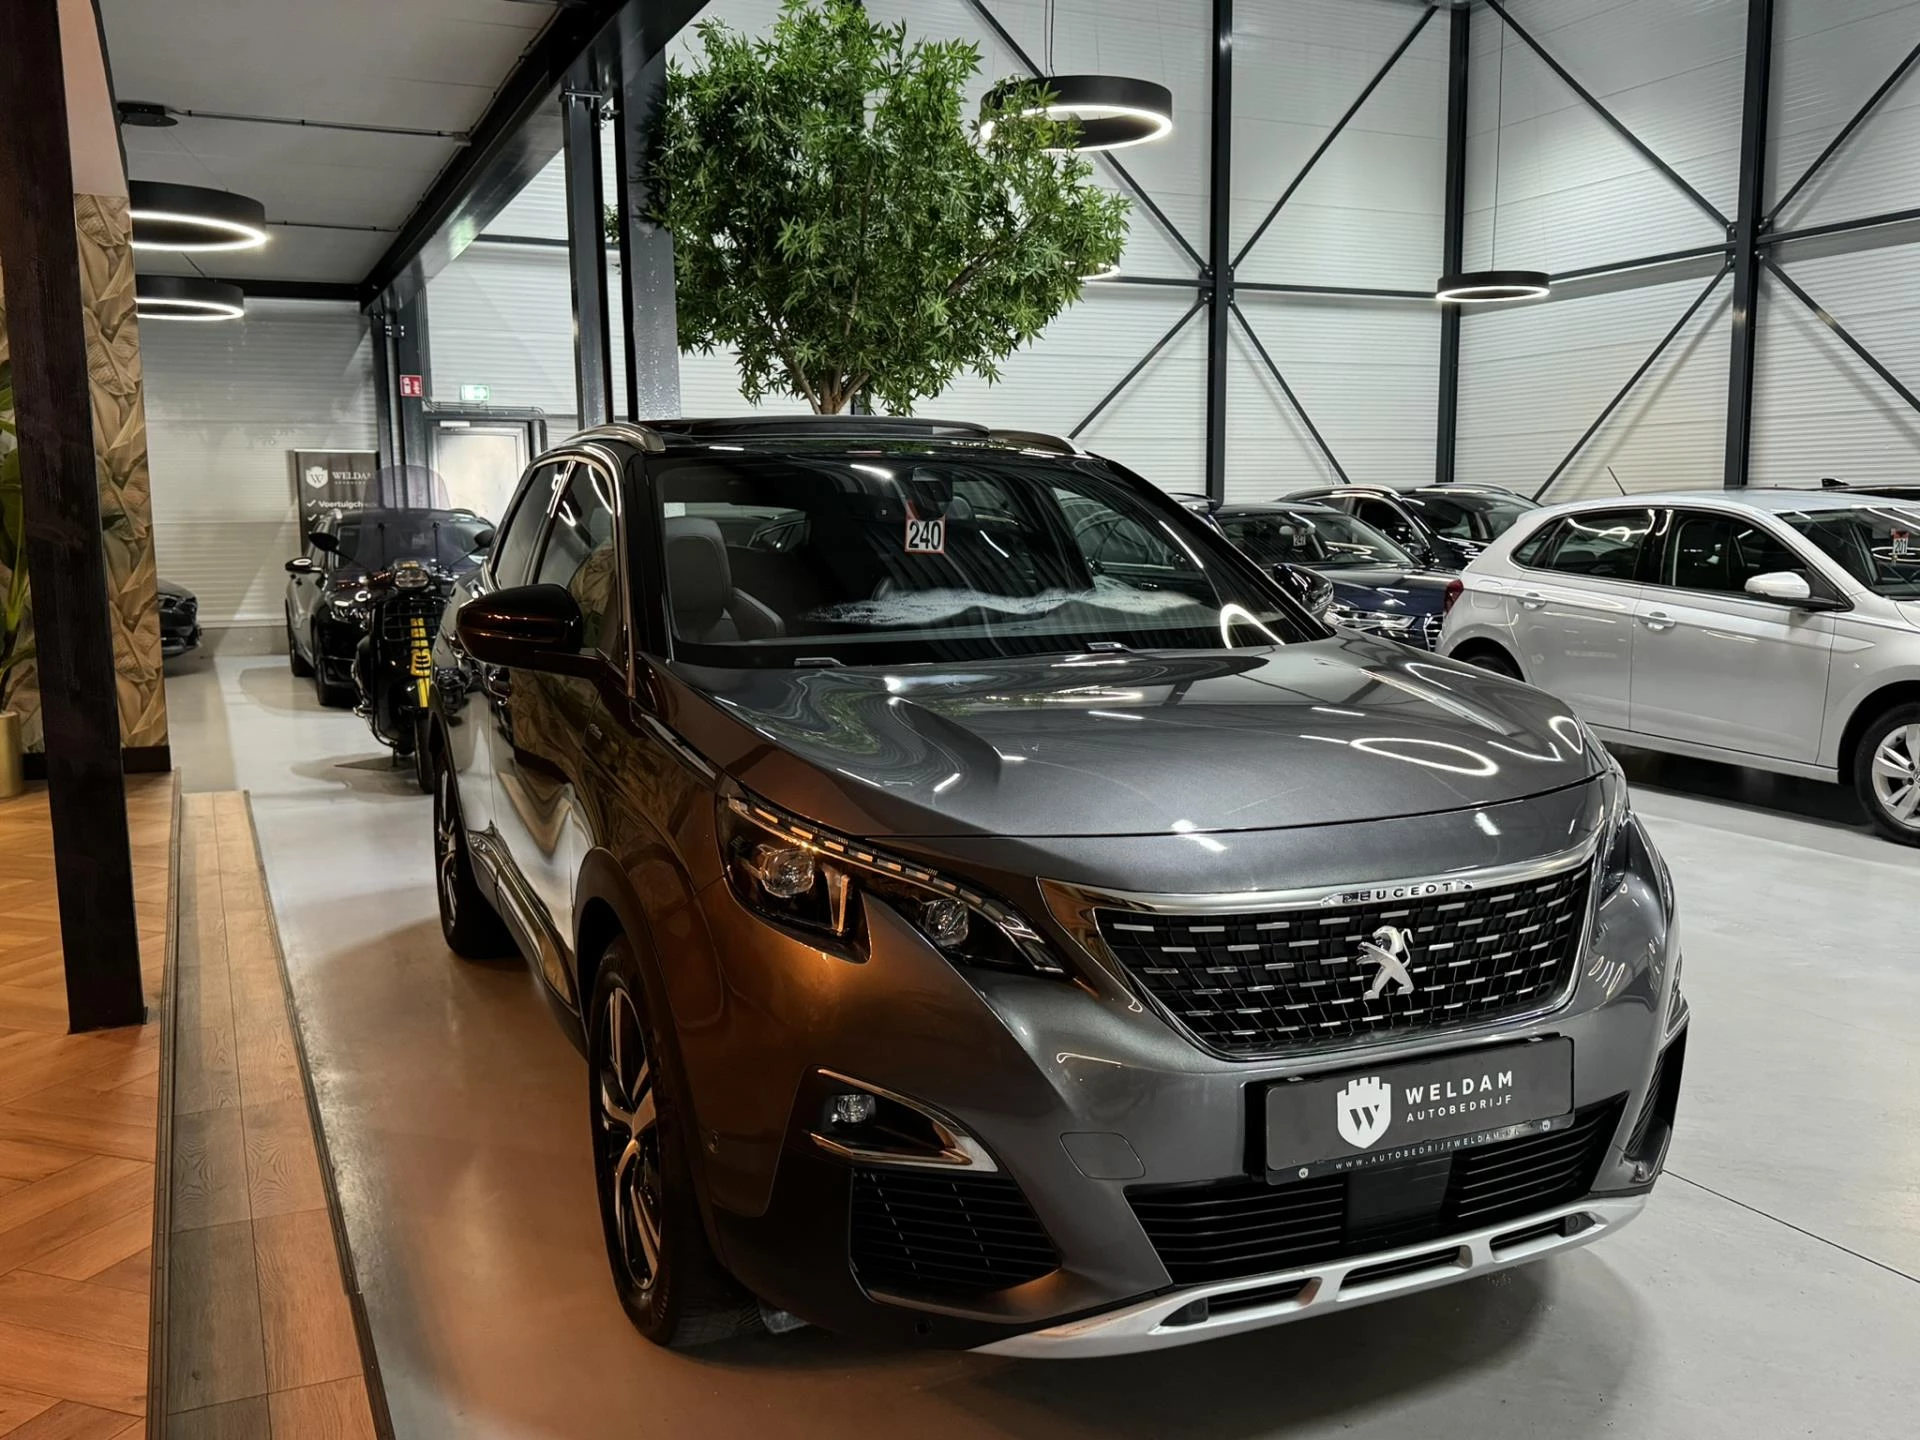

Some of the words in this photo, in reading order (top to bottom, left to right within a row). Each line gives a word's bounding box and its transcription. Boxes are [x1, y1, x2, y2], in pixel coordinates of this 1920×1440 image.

[908, 520, 941, 550] 240
[1894, 539, 1907, 554] 201
[1342, 882, 1452, 904] PEUGEOT
[1405, 1071, 1513, 1105] WELDAM
[1348, 1104, 1381, 1132] W
[1406, 1094, 1512, 1123] AUTOBEDRIJF
